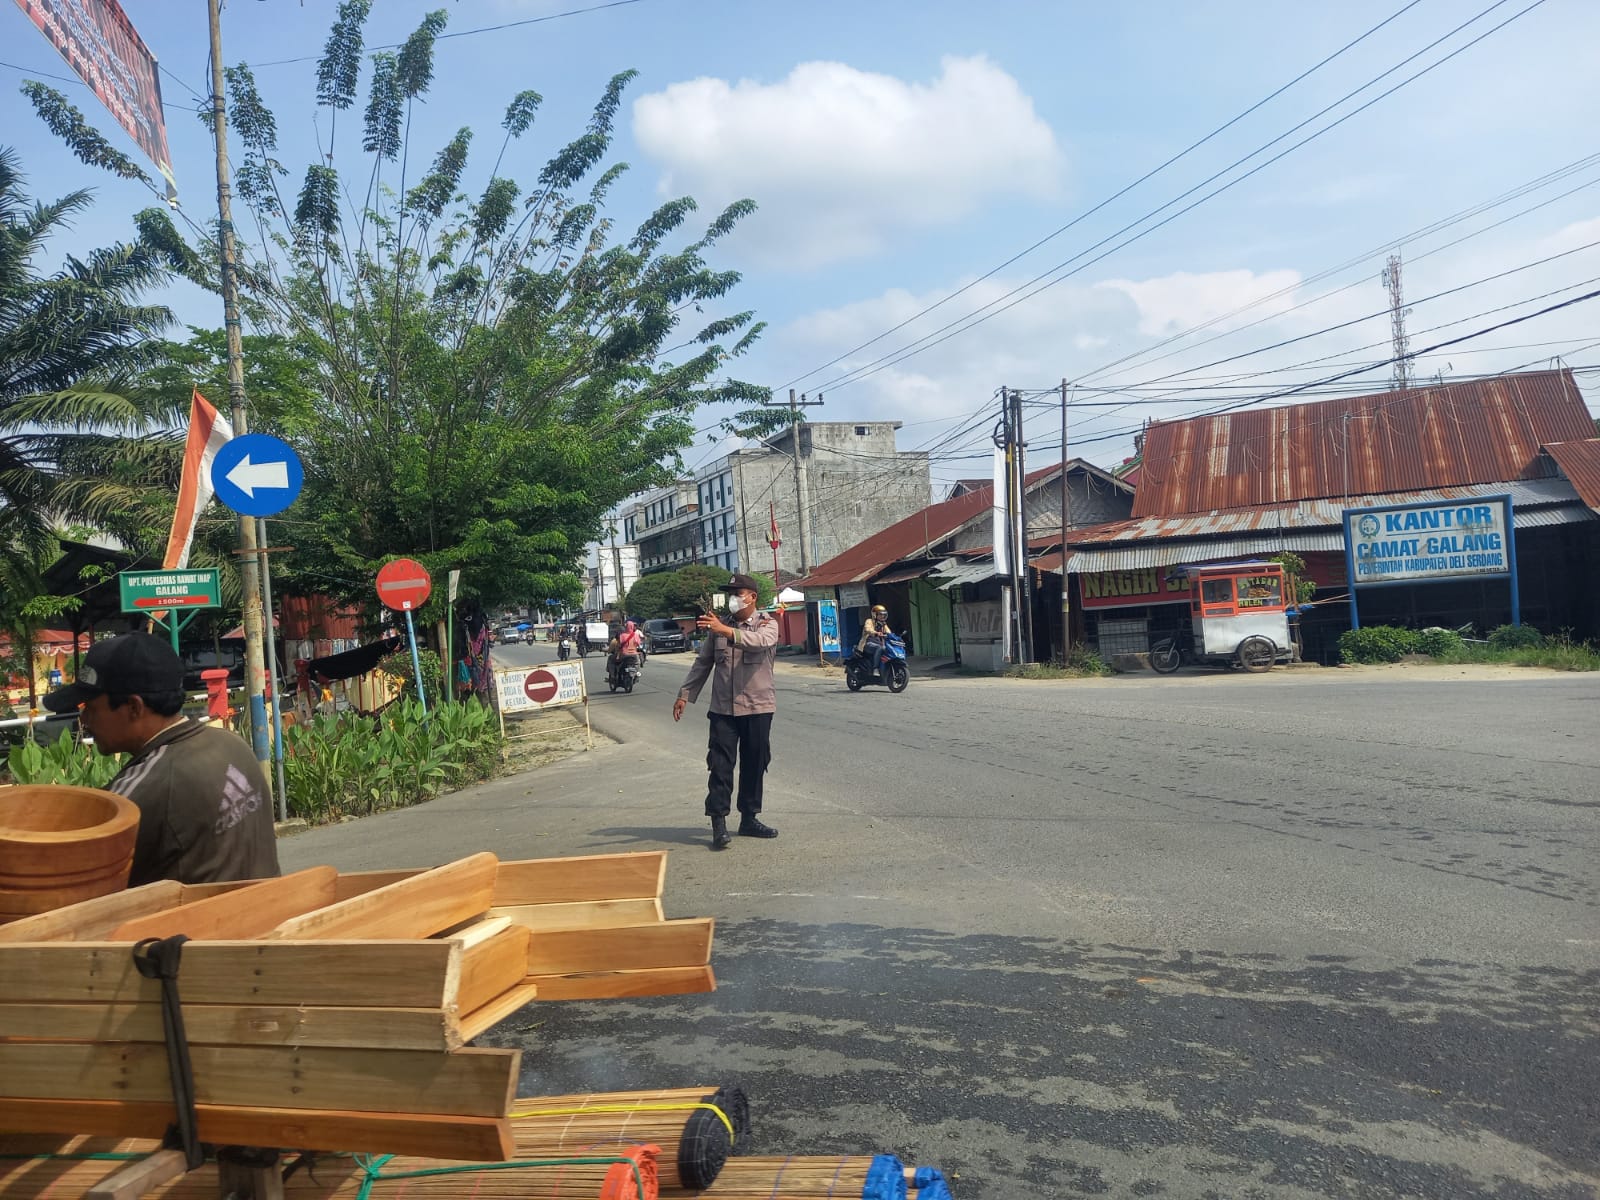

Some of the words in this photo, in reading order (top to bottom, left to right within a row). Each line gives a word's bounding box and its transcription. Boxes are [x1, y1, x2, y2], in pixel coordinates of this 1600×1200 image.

[1386, 506, 1492, 532] KANTOR
[1357, 539, 1420, 560] CAMAT
[1427, 533, 1502, 555] GALANG
[1358, 559, 1403, 575] PEMERINTAH
[1405, 557, 1447, 572] KABUPATEN
[1450, 555, 1466, 569] DELI
[1467, 553, 1503, 568] SERDANG
[141, 575, 176, 586] PUSKESMAS
[176, 574, 197, 584] RAWAT
[155, 585, 189, 596] GALANG
[1083, 568, 1159, 598] NAGIH
